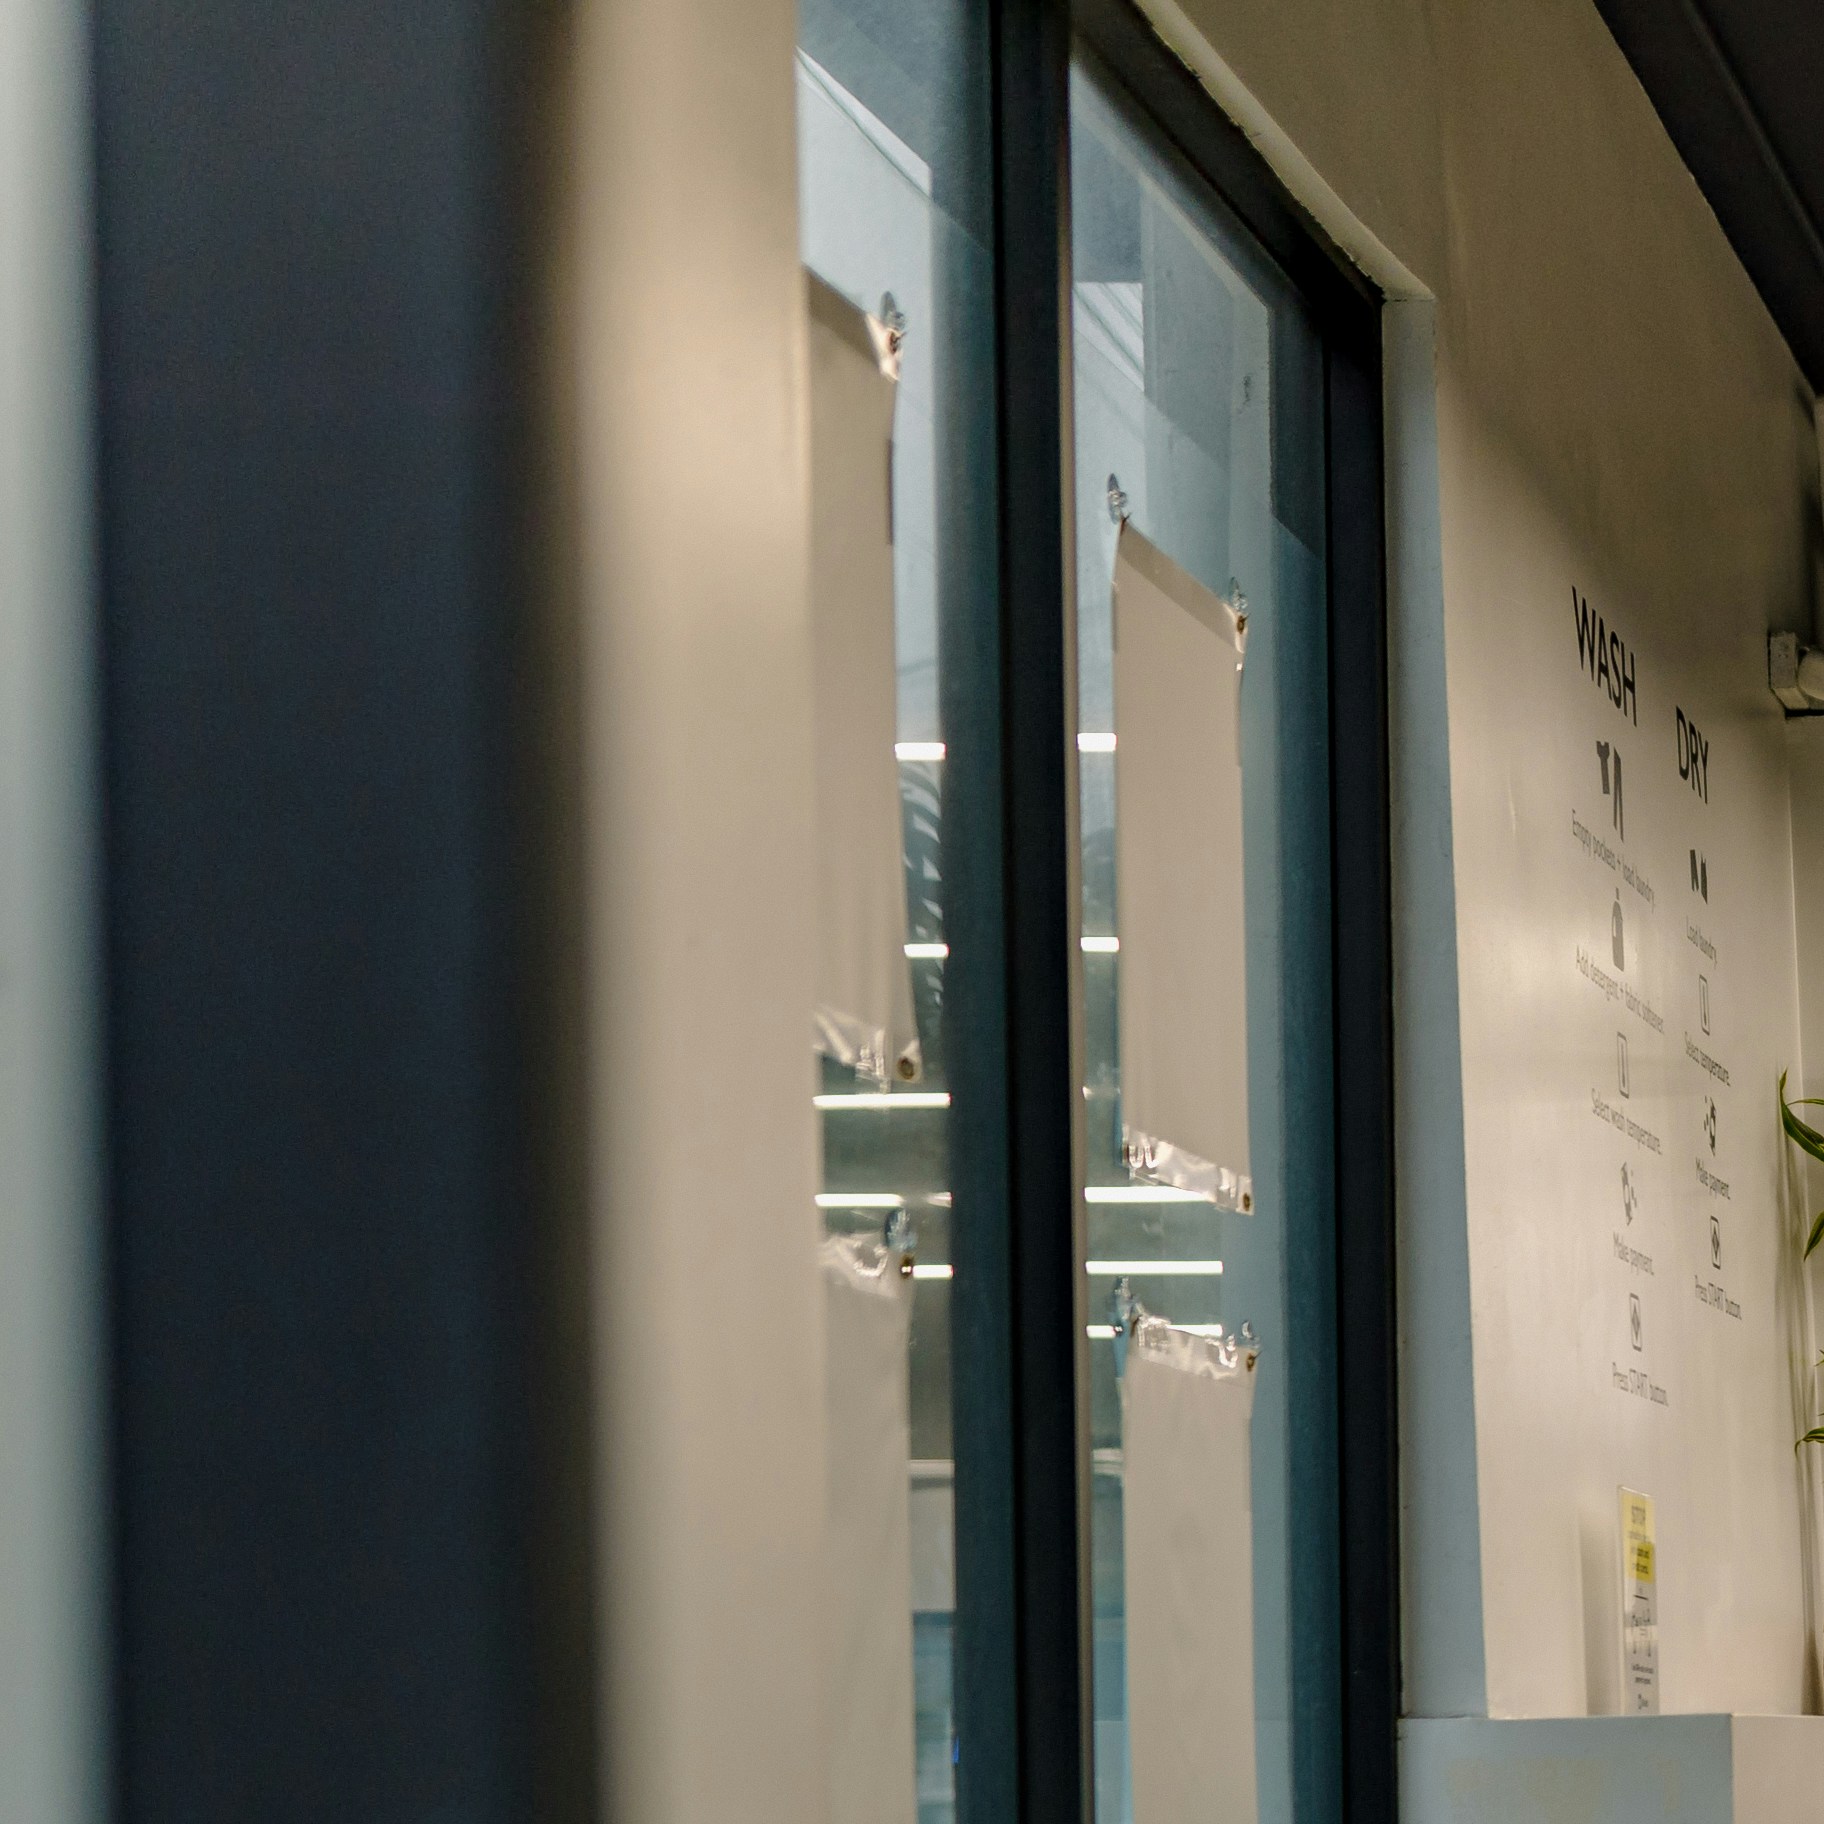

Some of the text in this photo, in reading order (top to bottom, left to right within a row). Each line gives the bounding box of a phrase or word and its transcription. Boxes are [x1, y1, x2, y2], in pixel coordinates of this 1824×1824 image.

[1571, 584, 1637, 728] WASH
[1675, 704, 1709, 805] DRY
[1686, 915, 1698, 948] Load
[1576, 945, 1589, 978] Add
[1685, 1030, 1700, 1064] Select
[1591, 1088, 1610, 1123] Select
[1610, 1104, 1625, 1132] wash
[1696, 1156, 1709, 1187] Make
[1613, 1231, 1630, 1264] Make
[1694, 1274, 1708, 1304] Press
[1708, 1282, 1724, 1311] START
[1612, 1361, 1629, 1392] Press
[1629, 1367, 1649, 1399] START
